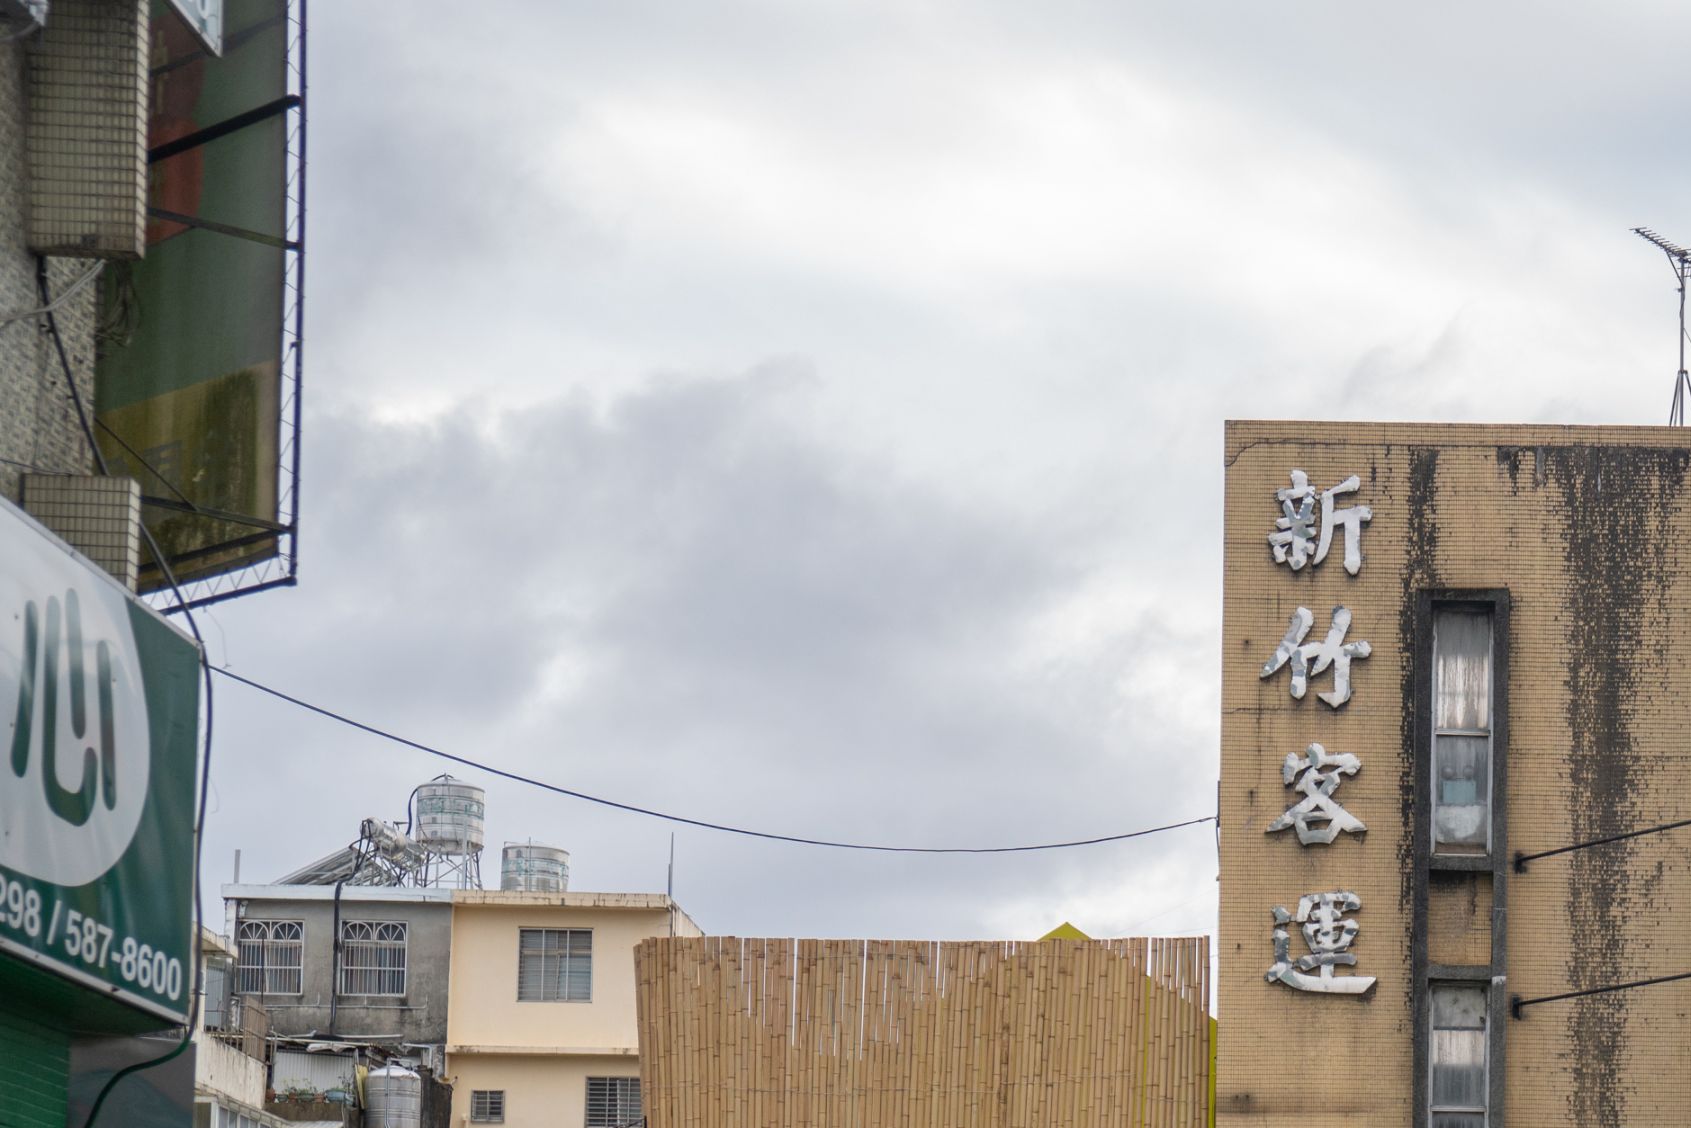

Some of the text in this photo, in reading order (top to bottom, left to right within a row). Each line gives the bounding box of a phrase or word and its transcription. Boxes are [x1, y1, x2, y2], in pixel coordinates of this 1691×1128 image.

[1260, 469, 1377, 994] 新竹客運
[65, 909, 182, 1001] 587-8600
